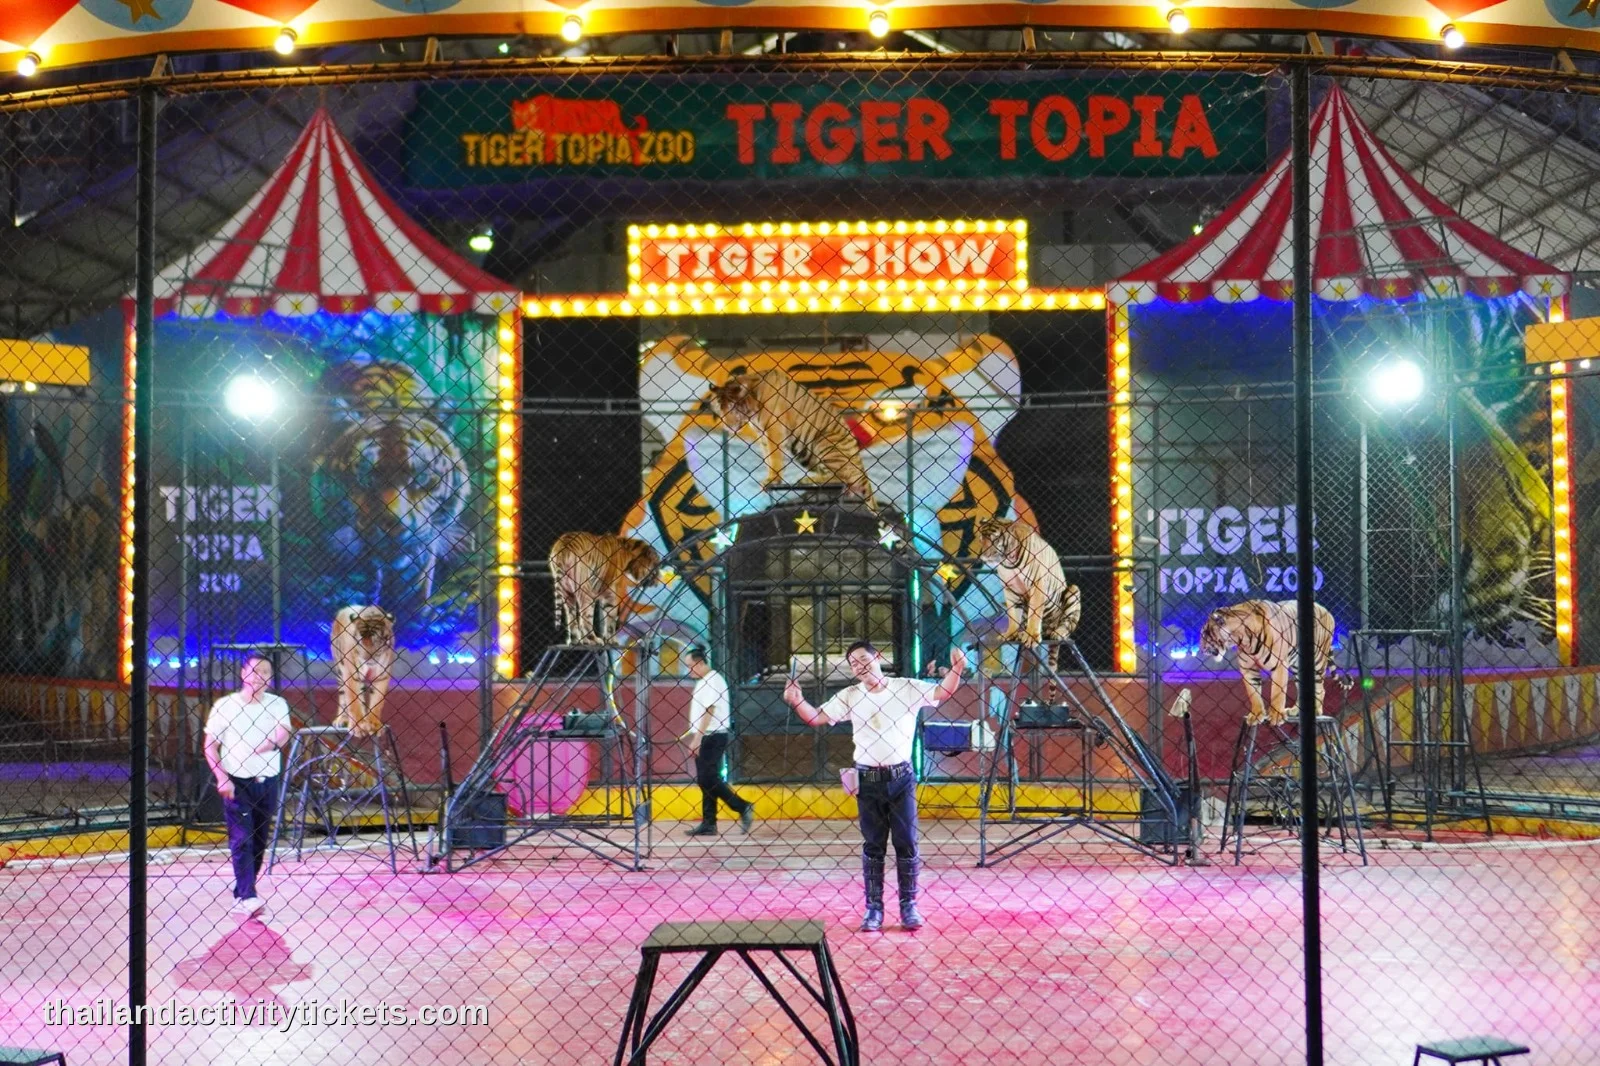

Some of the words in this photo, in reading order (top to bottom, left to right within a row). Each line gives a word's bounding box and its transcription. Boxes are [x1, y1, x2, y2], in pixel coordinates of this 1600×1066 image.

[463, 132, 544, 167] TIGER
[552, 131, 630, 166] TOPIA
[638, 130, 695, 165] ZOO
[728, 102, 952, 165] TIGER
[990, 94, 1219, 161] TOPIA
[656, 241, 813, 280] TIGER
[842, 238, 999, 279] SHOW
